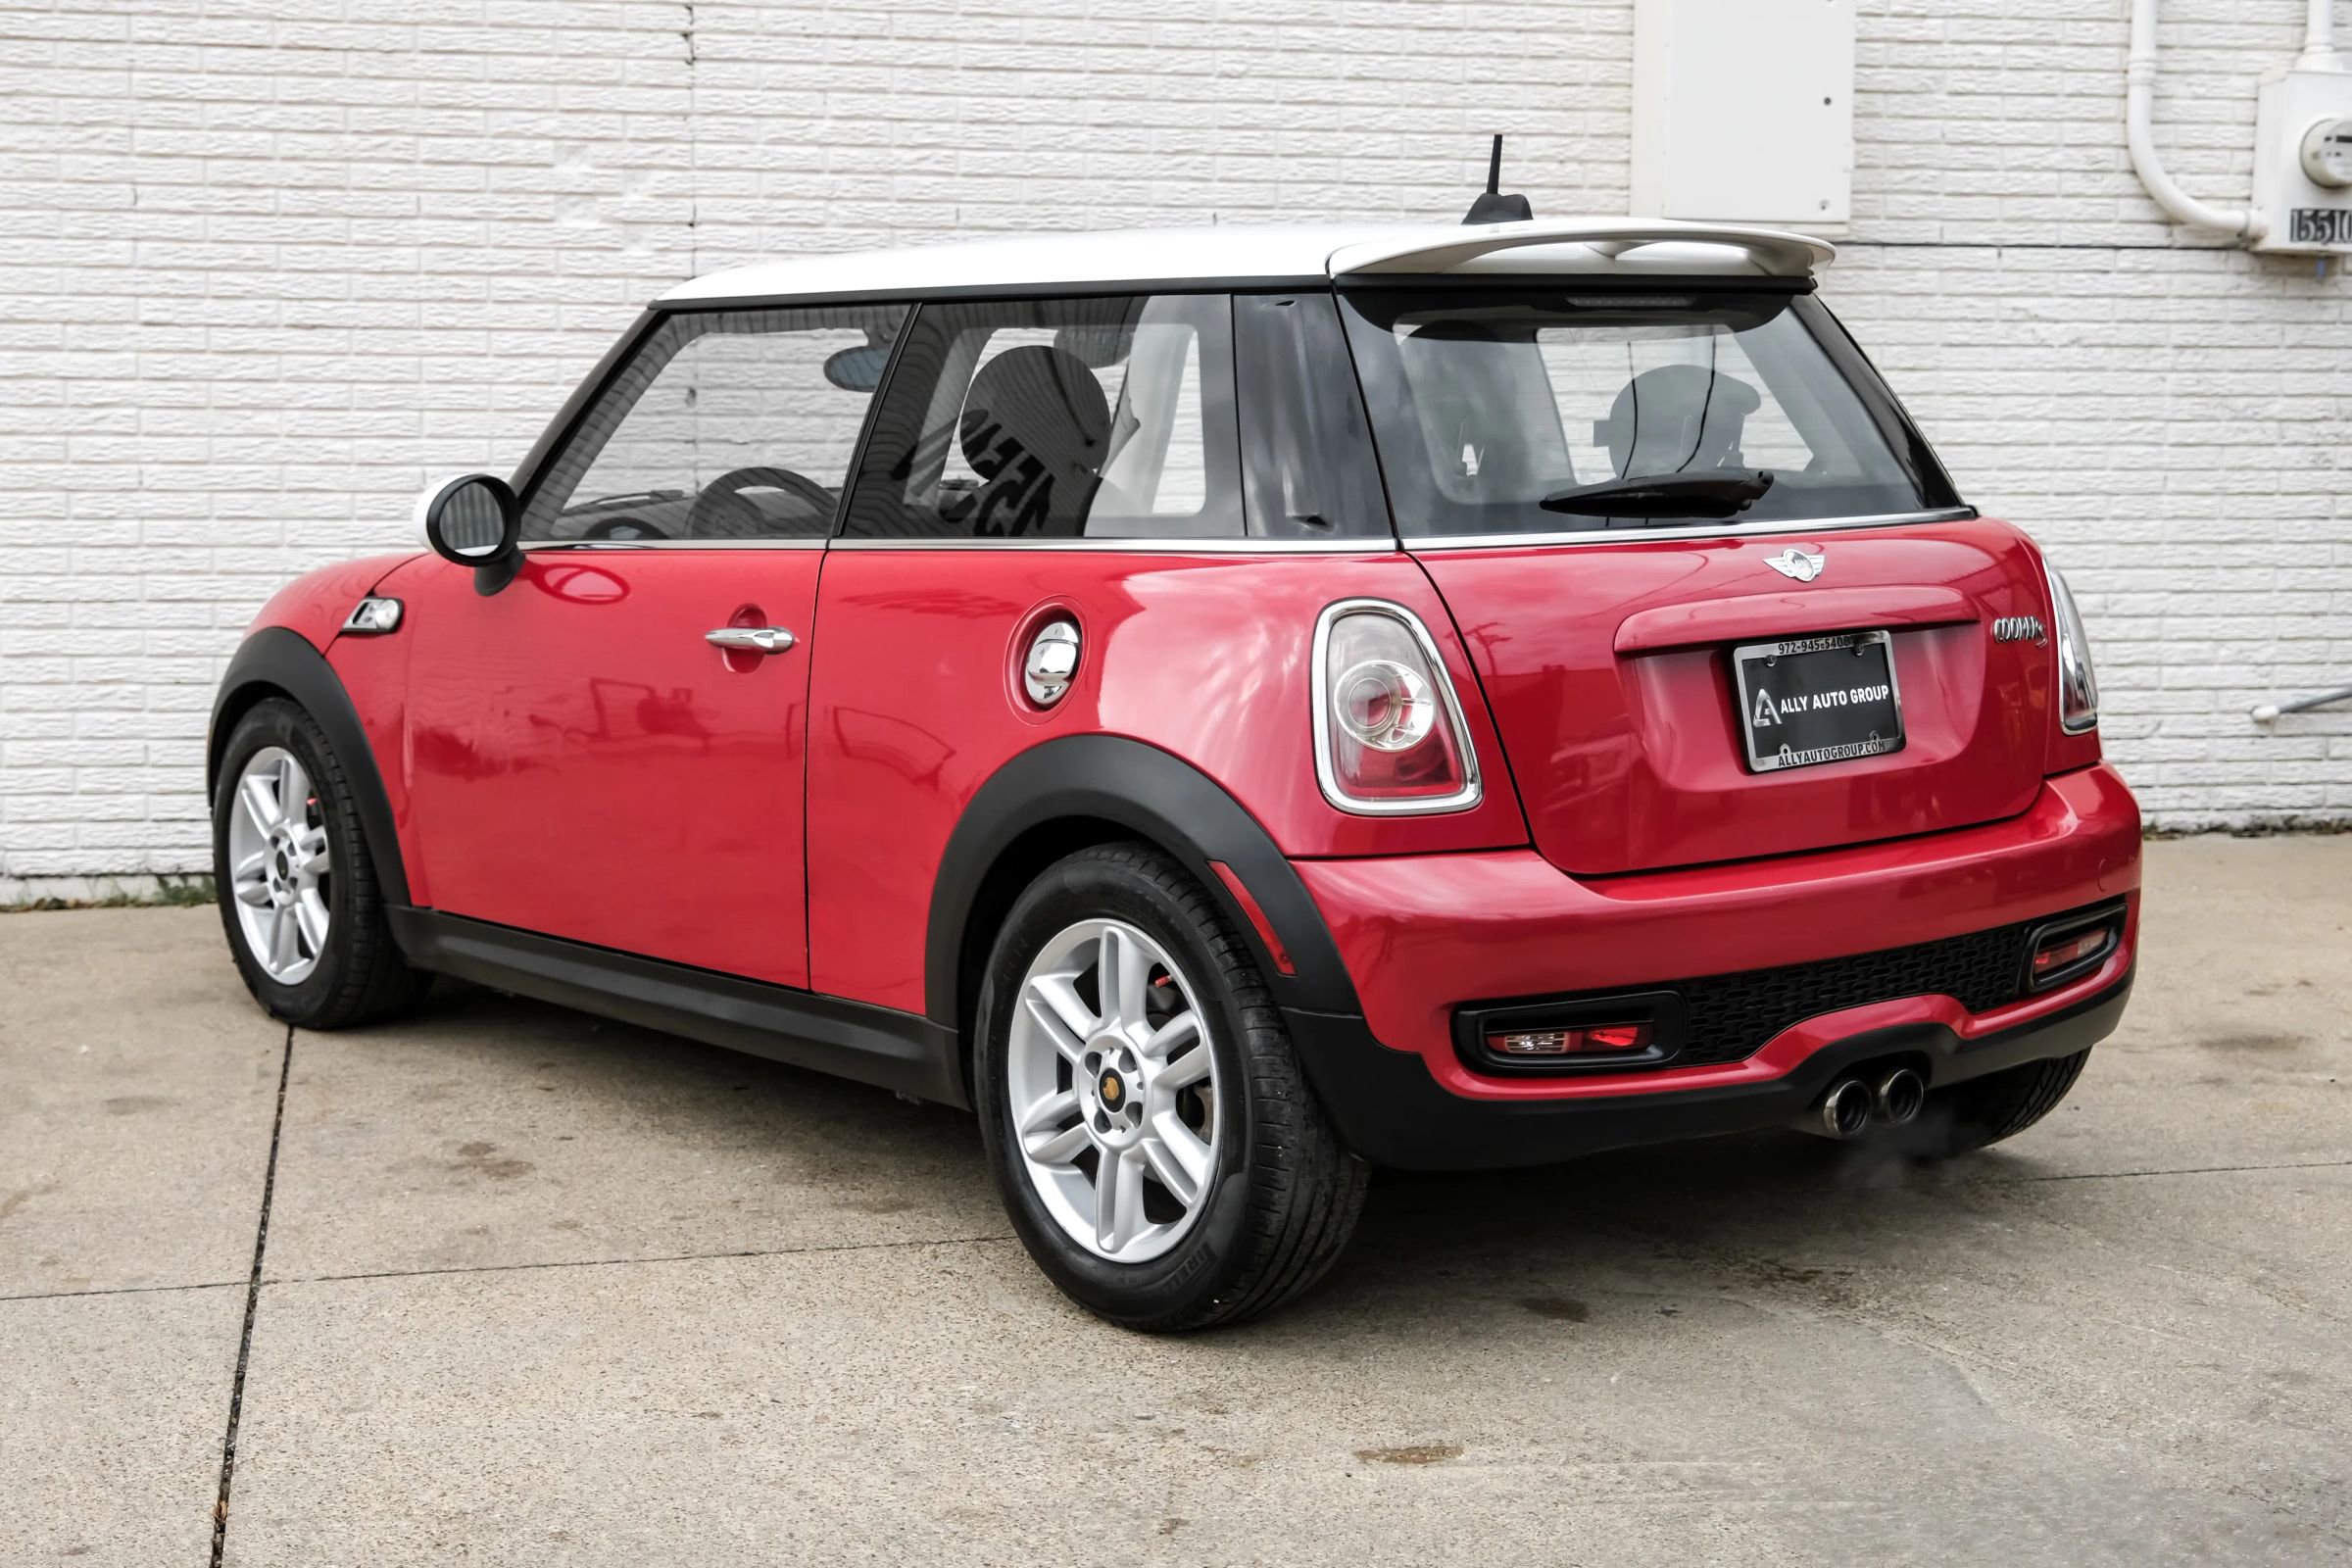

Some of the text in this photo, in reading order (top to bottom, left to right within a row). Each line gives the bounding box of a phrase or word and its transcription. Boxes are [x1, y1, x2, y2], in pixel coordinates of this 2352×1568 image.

[2290, 210, 2352, 245] 15510
[1781, 685, 1888, 713] ALLY AUTO GROUP
[1779, 741, 1886, 766] ALLYAUTOGROUP.COM
